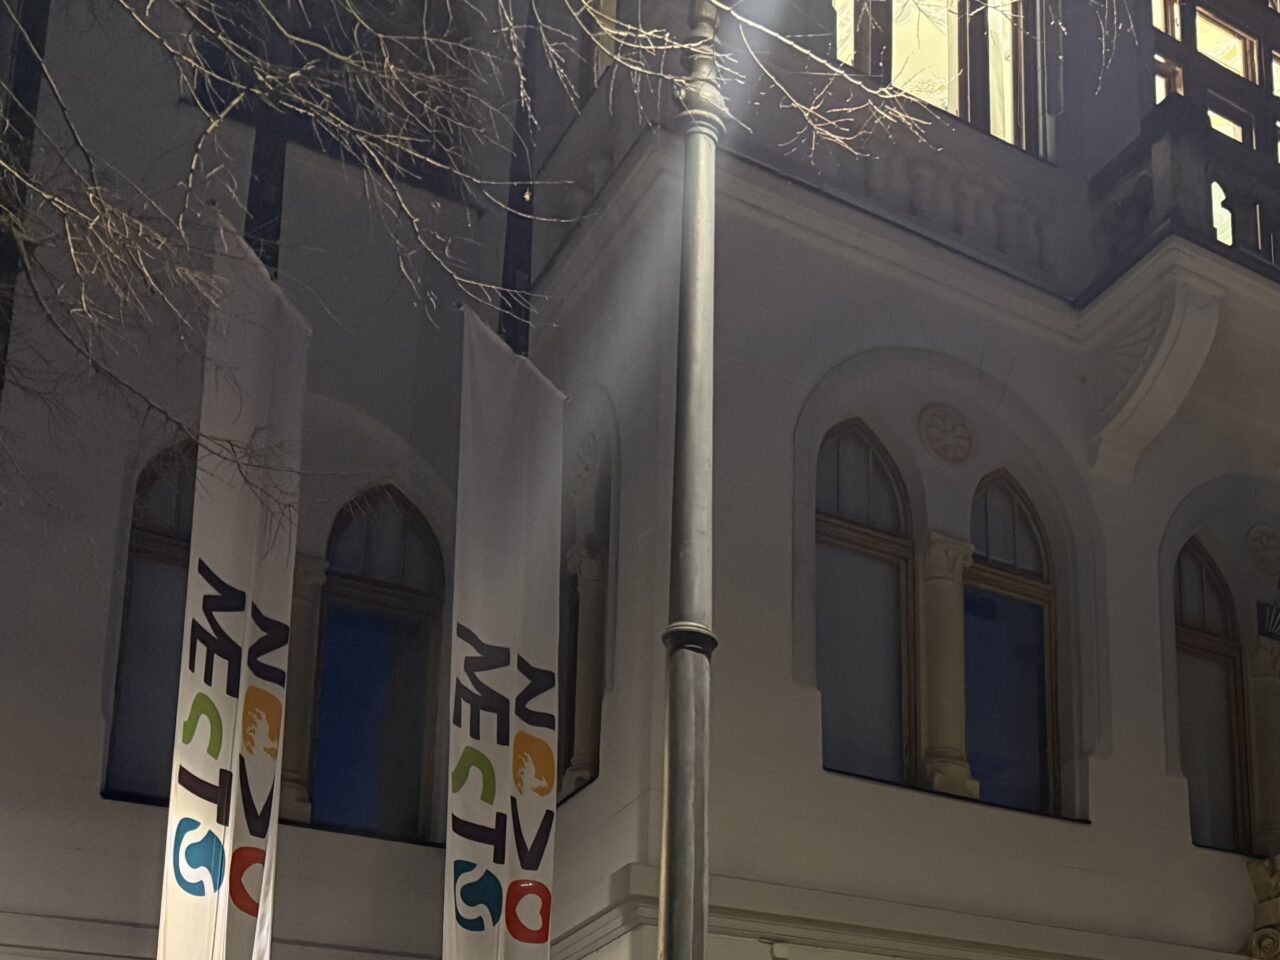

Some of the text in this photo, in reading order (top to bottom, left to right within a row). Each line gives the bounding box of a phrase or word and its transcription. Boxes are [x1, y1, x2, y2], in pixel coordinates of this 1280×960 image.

[172, 557, 246, 897] MESTO
[228, 601, 290, 918] NOVO
[451, 622, 511, 932] MESTO
[505, 653, 556, 944] NOVO
